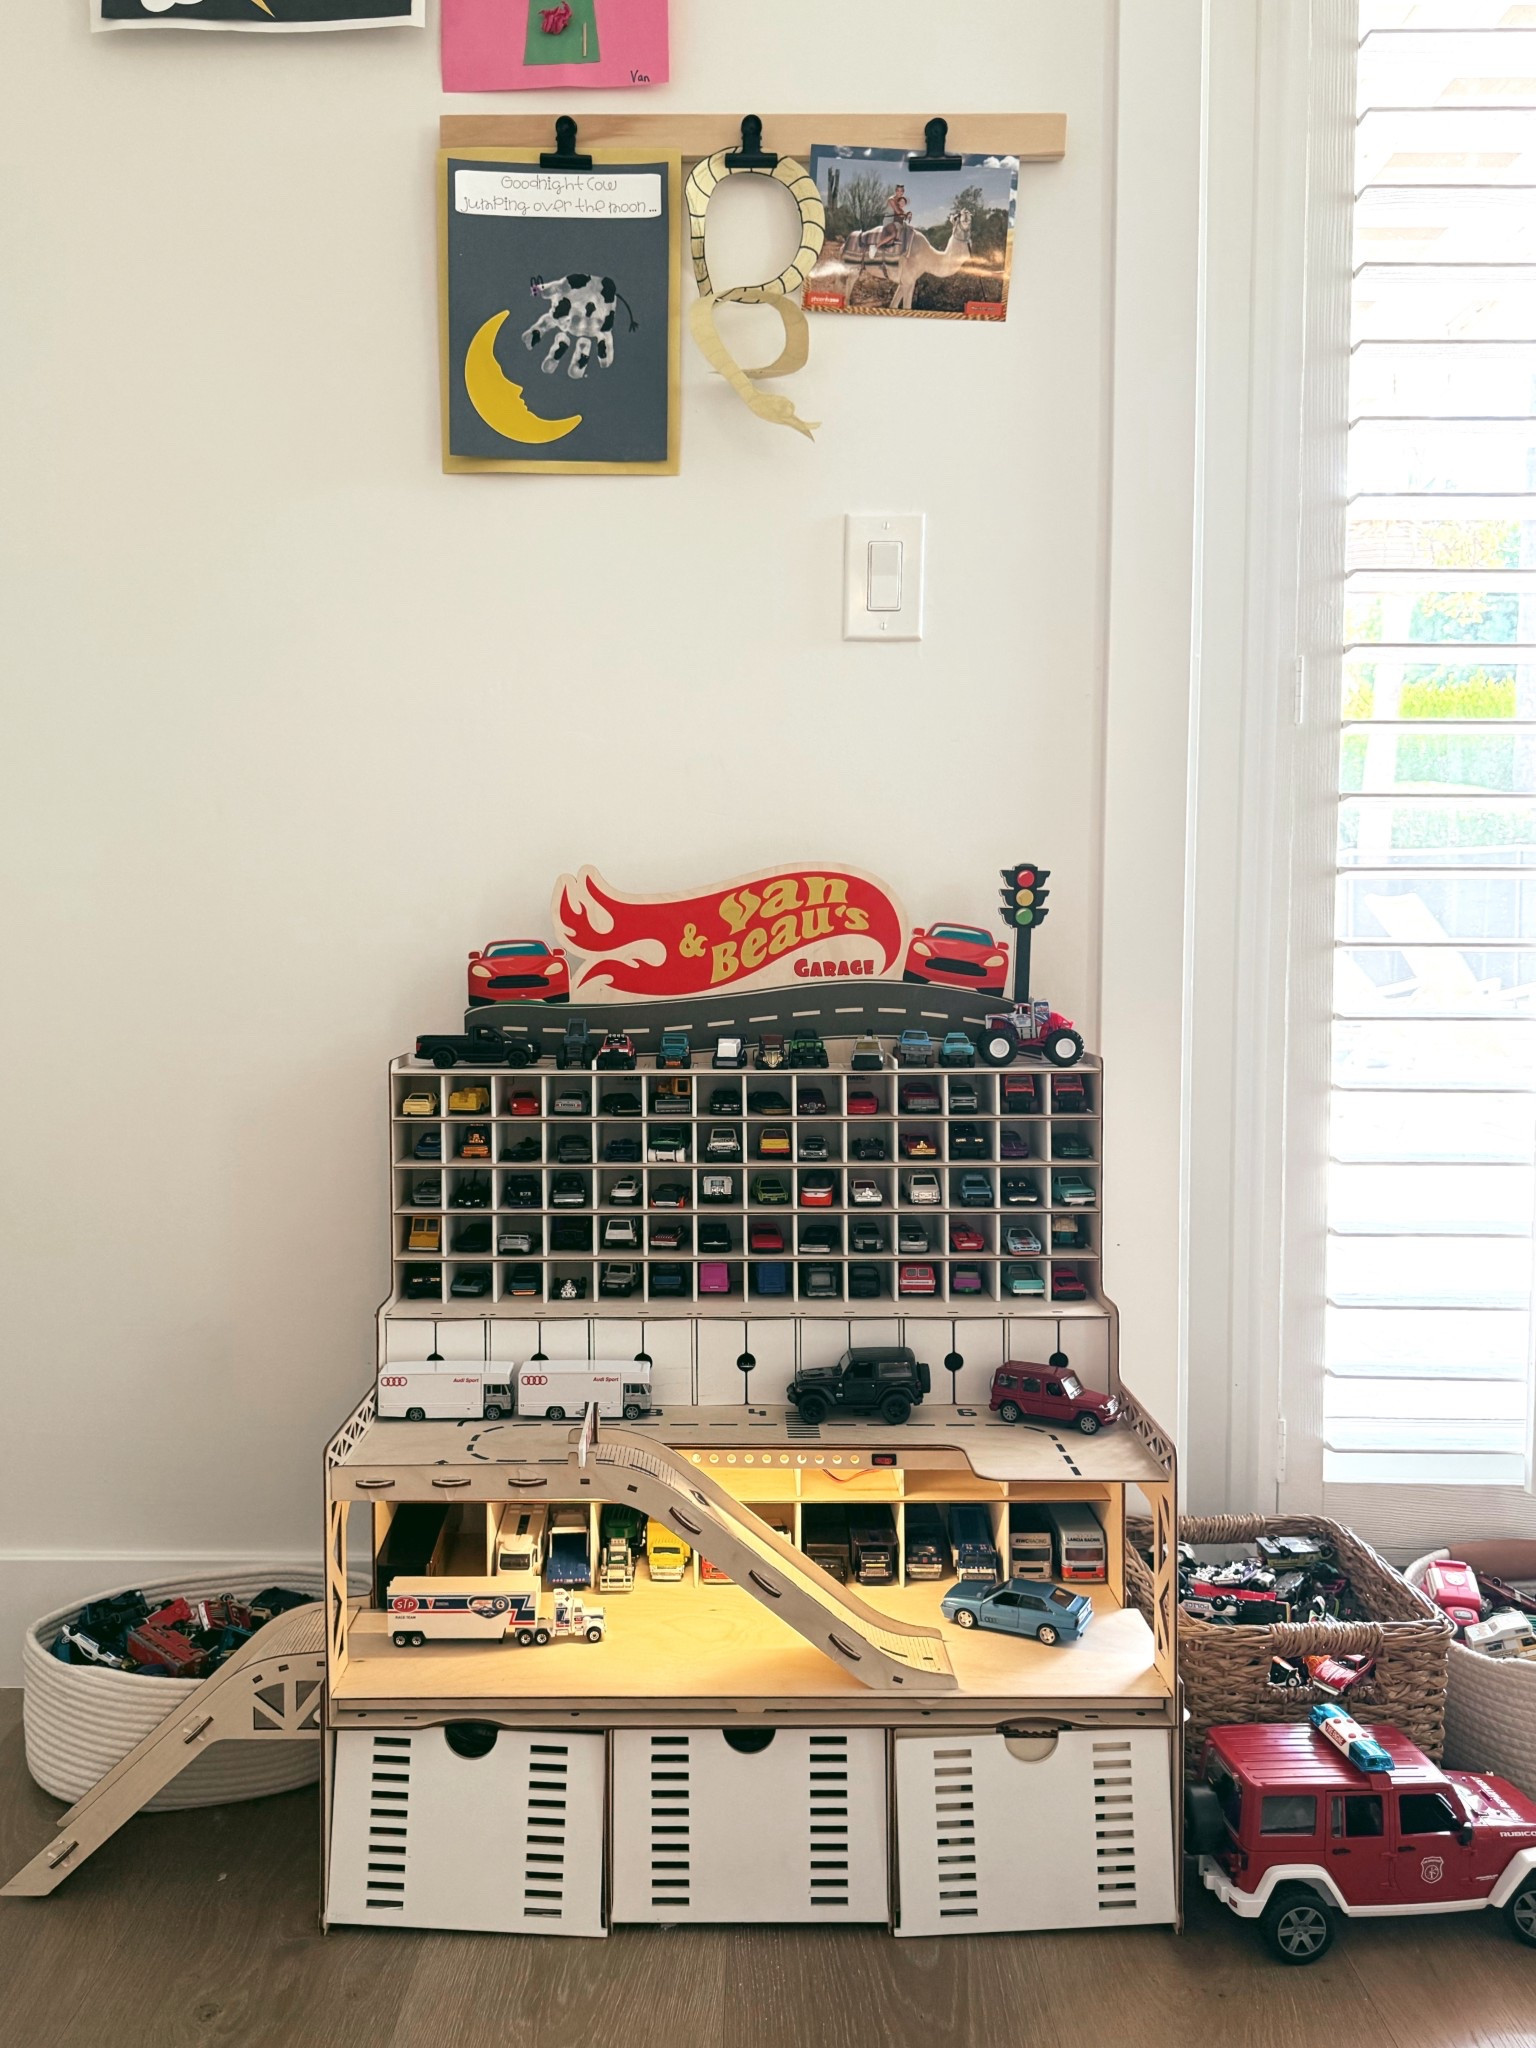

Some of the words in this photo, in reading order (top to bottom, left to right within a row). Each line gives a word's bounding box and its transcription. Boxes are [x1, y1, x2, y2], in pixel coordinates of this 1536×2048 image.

[630, 69, 650, 83] Van
[501, 175, 584, 195] Goodnight
[587, 176, 617, 191] Cow
[533, 199, 573, 212] over
[575, 198, 606, 213] the
[718, 876, 849, 936] Van
[679, 922, 709, 958] &
[710, 904, 870, 984] Beau's
[793, 958, 875, 978] GARAGE
[466, 1377, 479, 1385] Sport
[606, 1376, 619, 1384] Sport
[397, 1598, 415, 1610] STP
